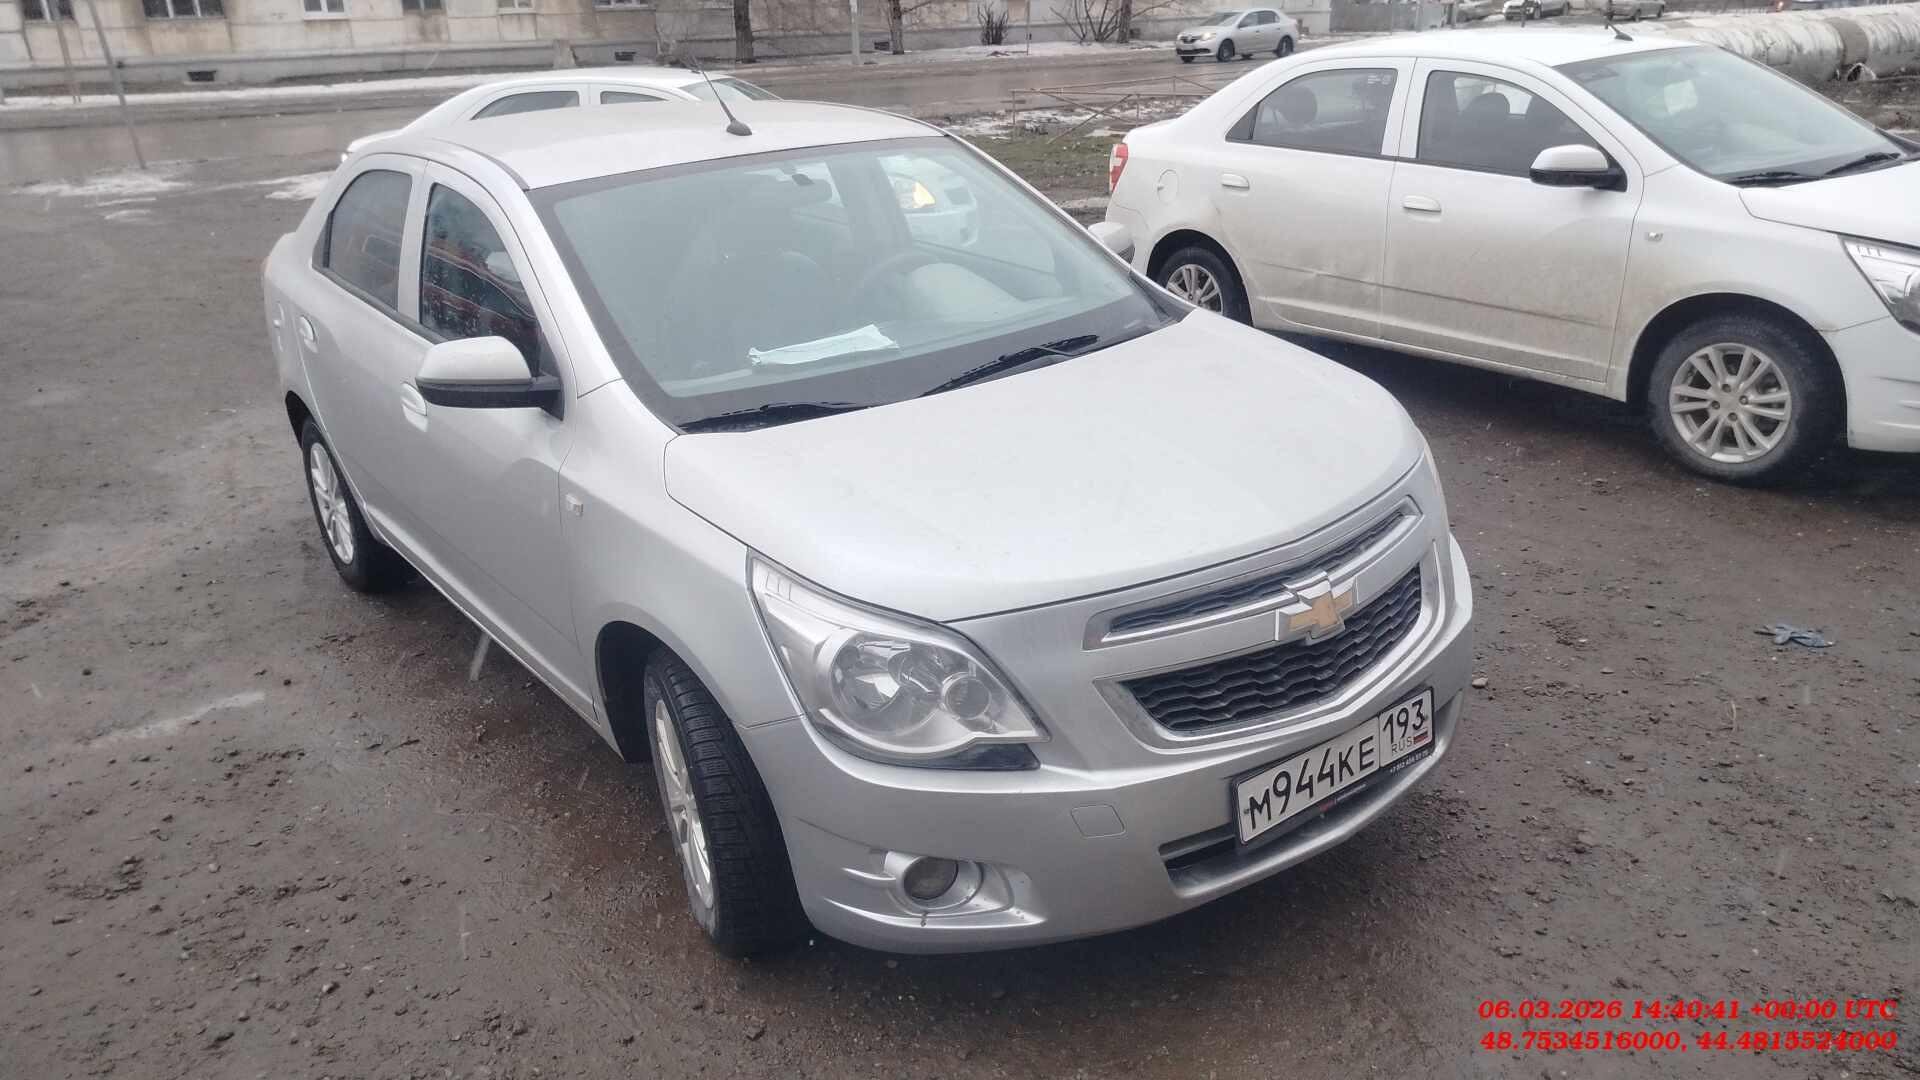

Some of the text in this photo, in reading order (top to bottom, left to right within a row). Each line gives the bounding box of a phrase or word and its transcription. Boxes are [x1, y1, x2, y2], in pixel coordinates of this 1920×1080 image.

[1249, 736, 1375, 829] М944КЕ
[1383, 698, 1425, 744] 193
[1391, 736, 1413, 753] RUS
